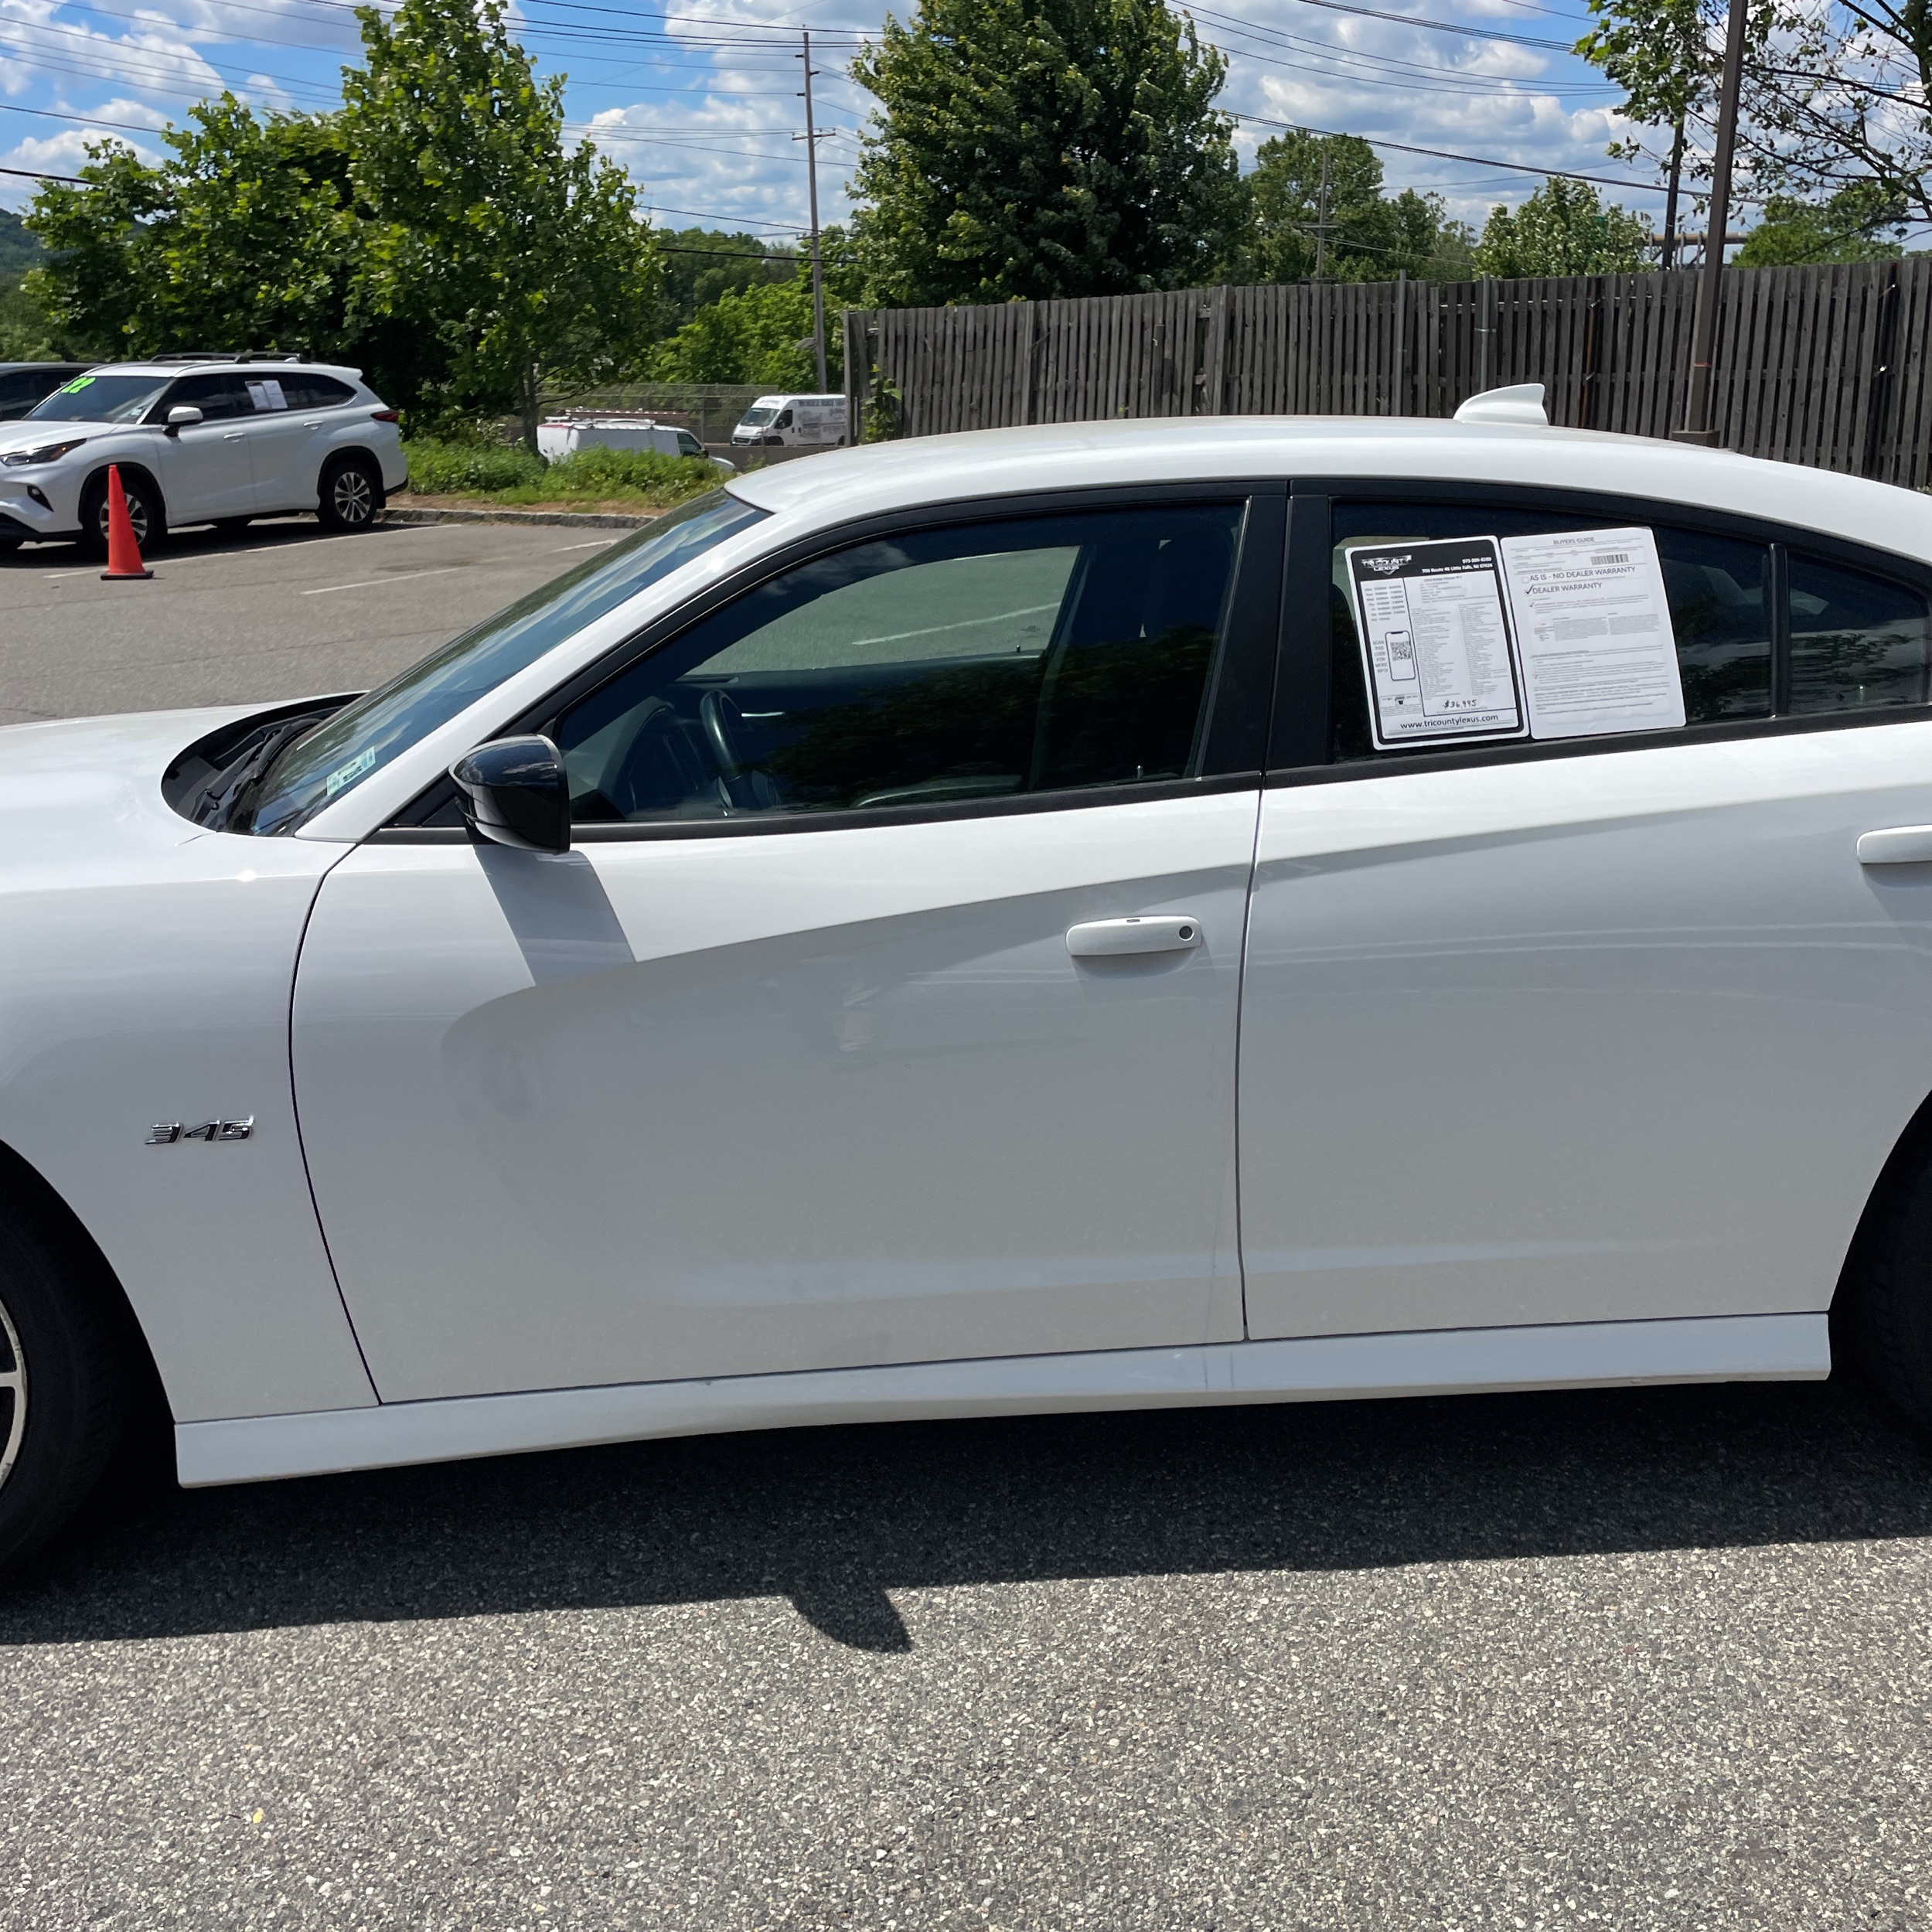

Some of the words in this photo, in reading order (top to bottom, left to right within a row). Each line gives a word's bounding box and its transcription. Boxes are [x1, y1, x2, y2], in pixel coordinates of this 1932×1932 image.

[1566, 569, 1594, 578] DEALER
[1595, 566, 1636, 575] WARRANTY
[1532, 585, 1560, 595] DEALER
[1561, 582, 1602, 591] WARRANTY
[1400, 714, 1498, 729] www.tricountylexus.com
[145, 1116, 254, 1144] 345
